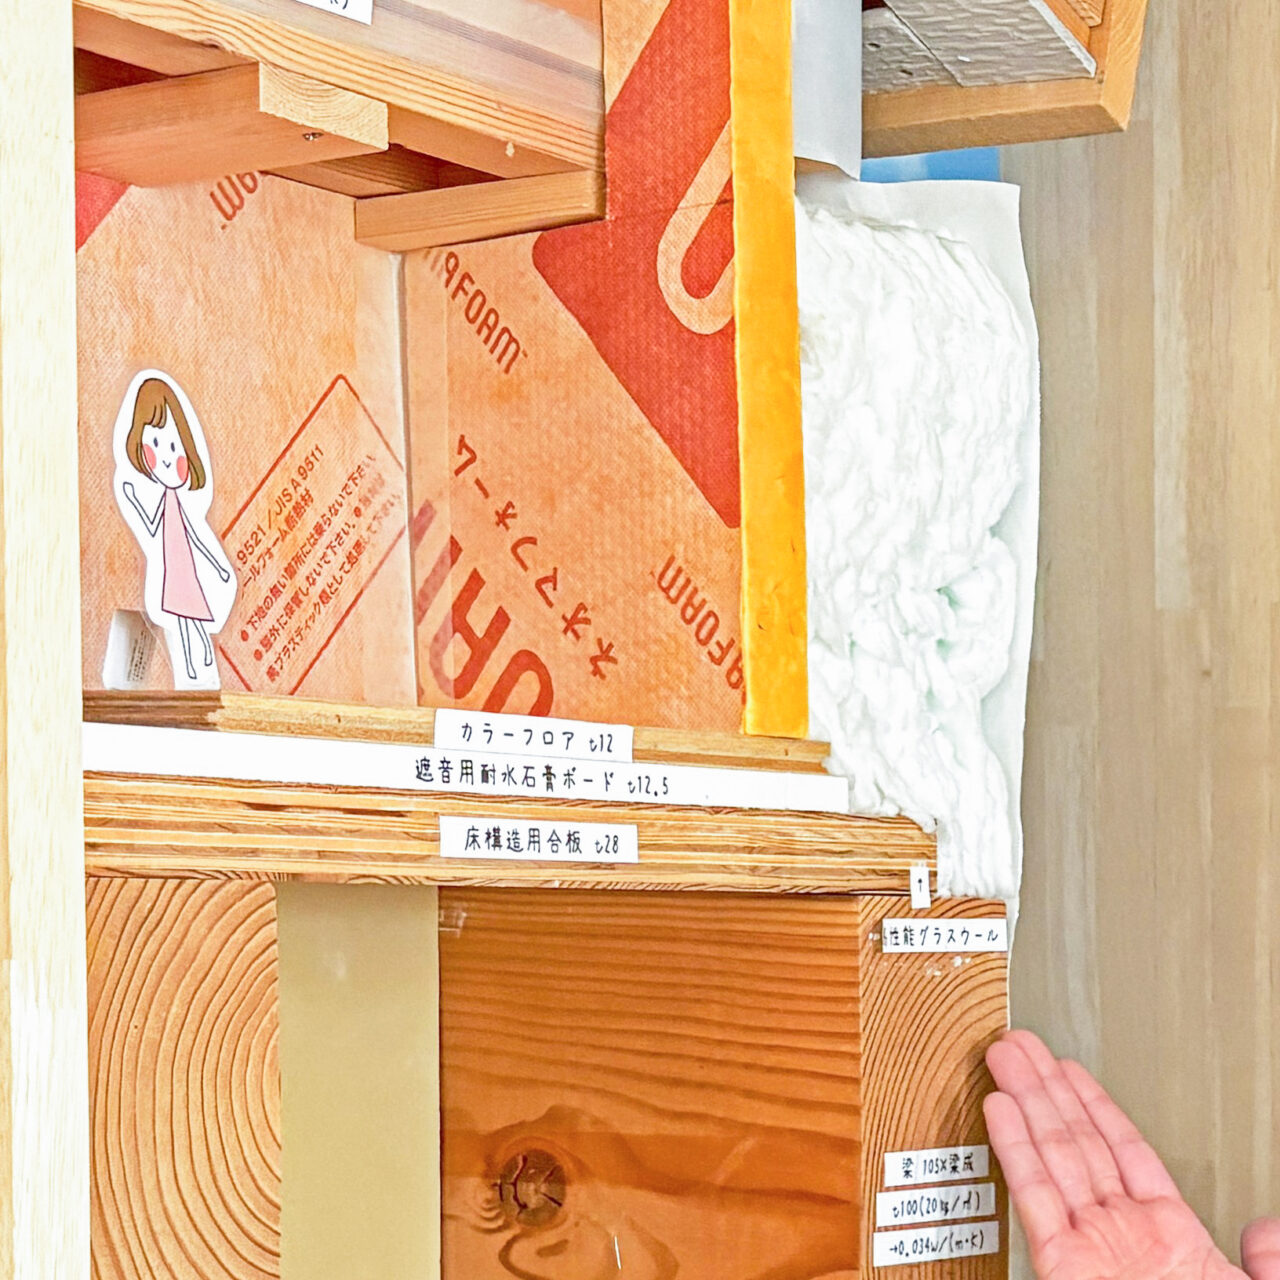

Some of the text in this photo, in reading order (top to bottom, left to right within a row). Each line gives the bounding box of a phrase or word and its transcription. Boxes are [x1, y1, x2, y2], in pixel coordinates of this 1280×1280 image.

[454, 434, 618, 680] ネオマフォーム
[460, 722, 613, 753] カラーフロア t12
[415, 755, 670, 797] 遮音用耐水石膏ボード t12.5
[464, 824, 619, 855] 床構造用合板 t28
[884, 924, 999, 947] 性能グラスウール
